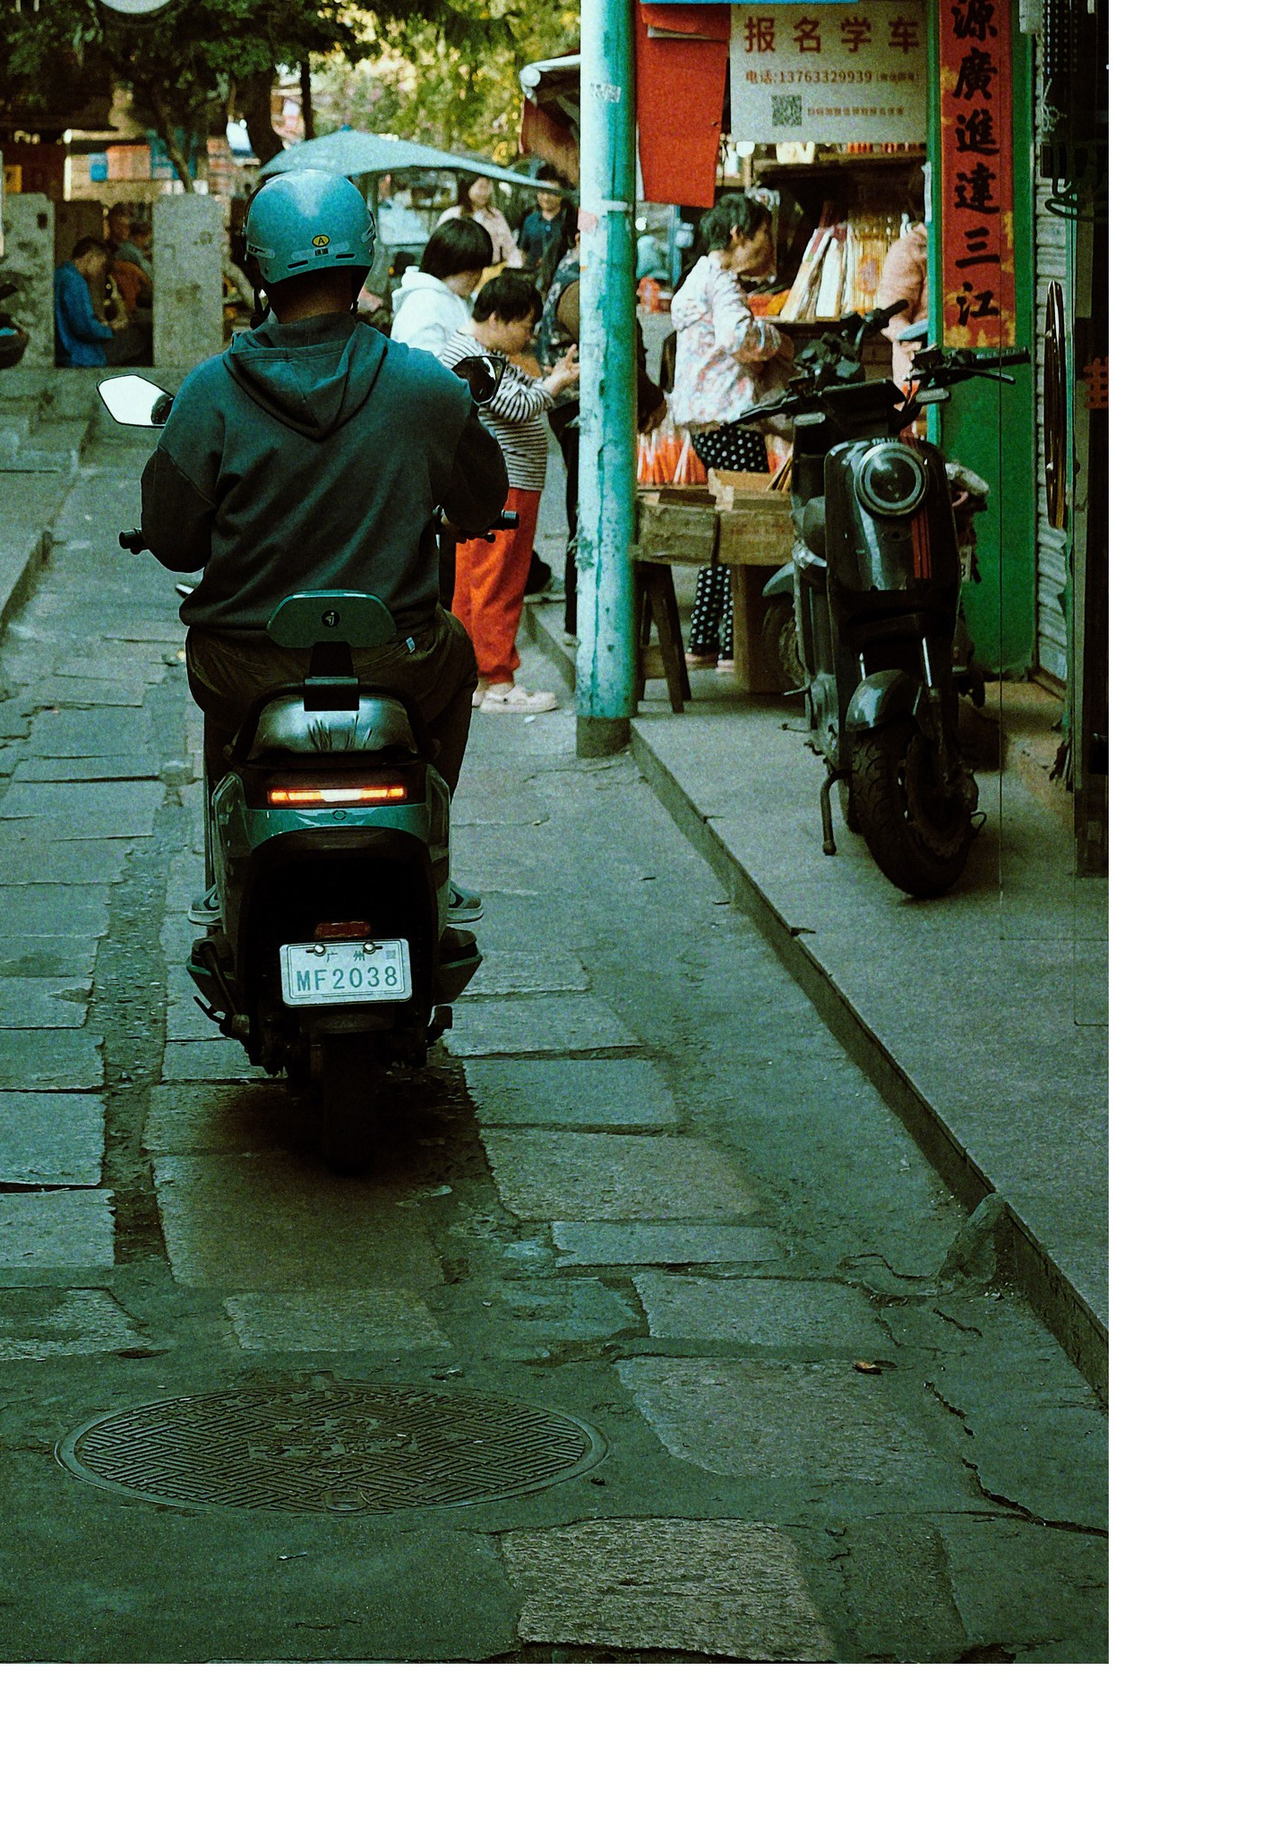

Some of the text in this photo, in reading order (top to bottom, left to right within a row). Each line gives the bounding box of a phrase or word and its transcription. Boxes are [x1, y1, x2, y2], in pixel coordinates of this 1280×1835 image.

[744, 16, 920, 54] 报名学车
[296, 965, 398, 992] MF2038
